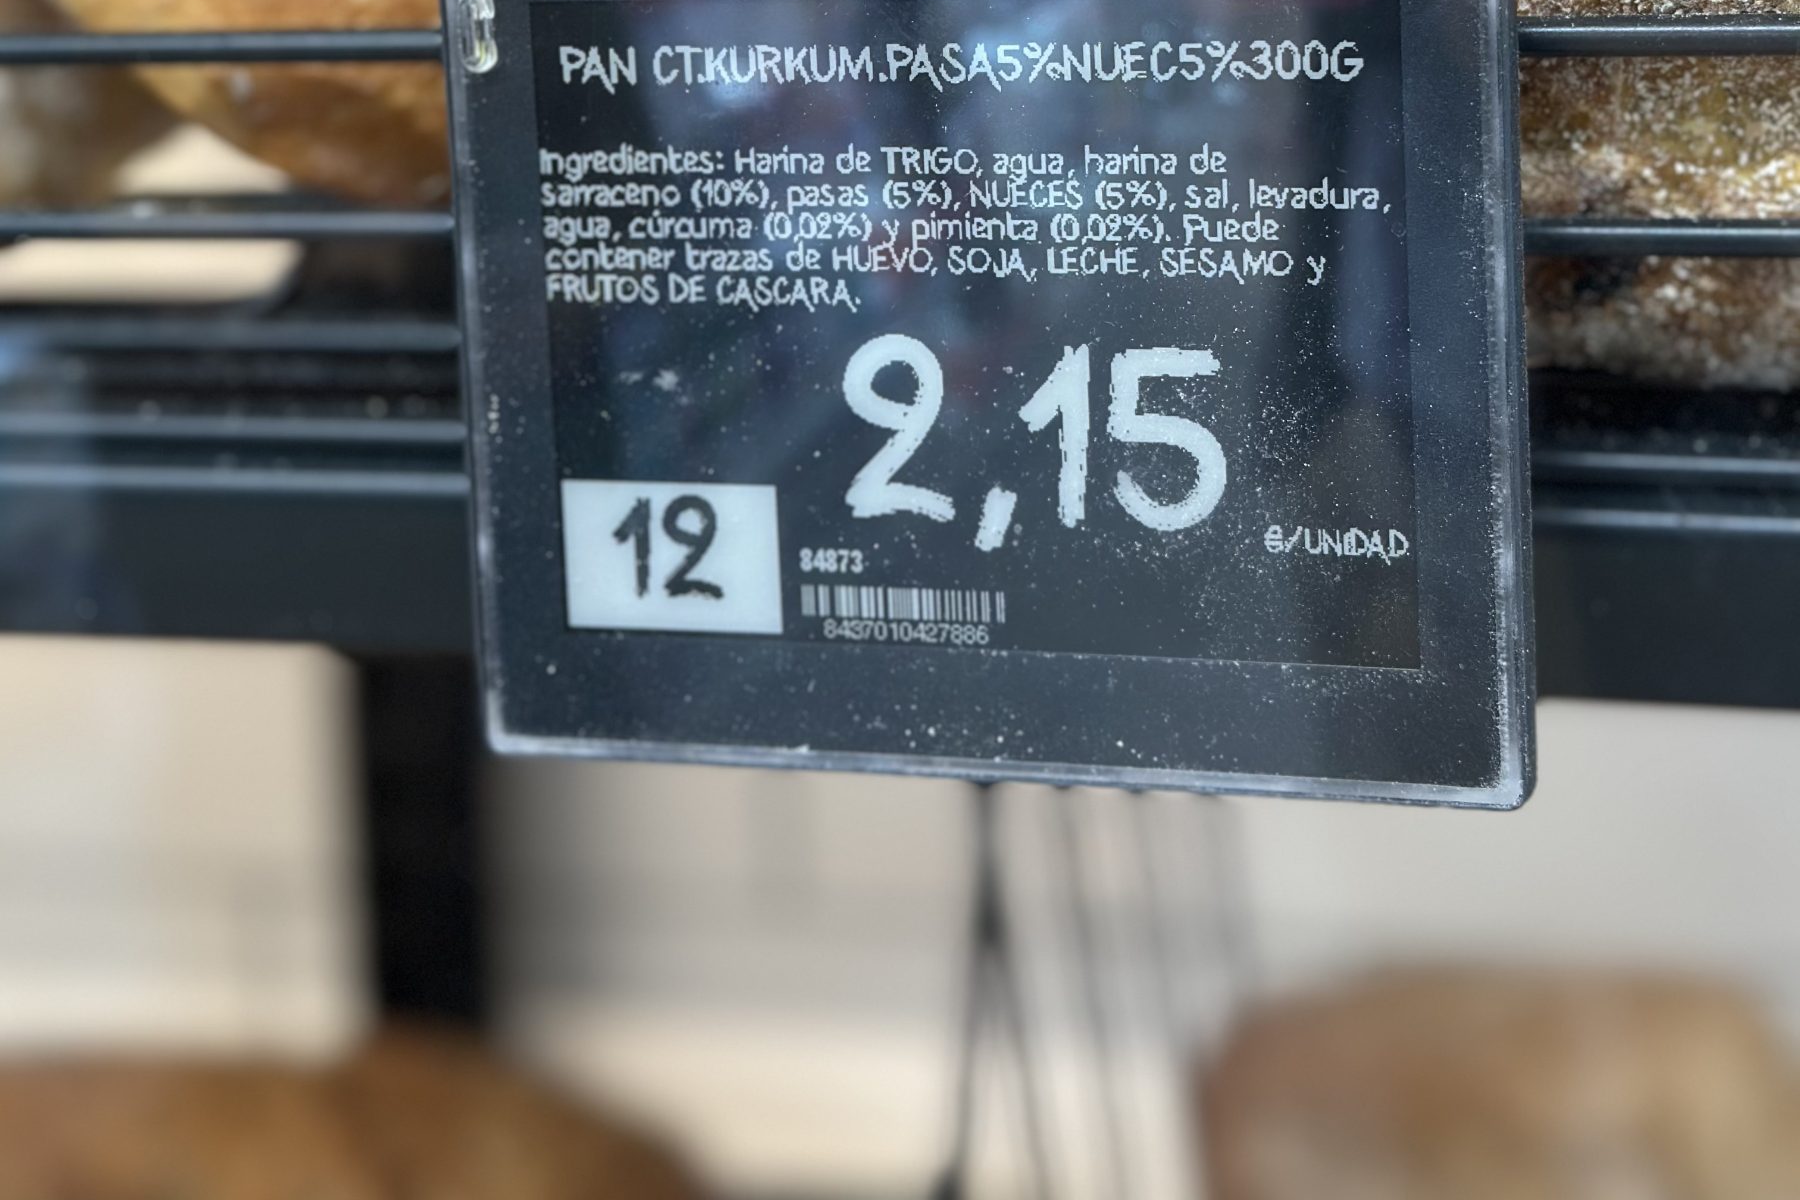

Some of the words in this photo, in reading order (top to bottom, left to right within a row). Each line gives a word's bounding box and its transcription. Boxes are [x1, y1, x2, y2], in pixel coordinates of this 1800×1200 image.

[559, 45, 637, 94] PAN
[539, 142, 725, 182] Ingredientes:
[734, 145, 824, 174] Harina
[836, 143, 871, 174] de
[881, 147, 983, 178] TRIGO,
[993, 153, 1075, 185] agua,
[1084, 144, 1177, 176] harina
[1190, 143, 1227, 174] de
[540, 182, 681, 207] sarraceno
[690, 178, 778, 212] (10%),
[787, 184, 869, 214] pasas
[882, 180, 960, 212] (5%),
[970, 180, 1084, 211] NUECES
[1095, 180, 1176, 213] (5%),
[1185, 178, 1240, 212] sal,
[1250, 176, 1391, 214] levadura,
[542, 215, 621, 246] agua,
[628, 209, 752, 239] cúrcuma
[763, 212, 872, 242] (0,02%)
[881, 219, 900, 250] y
[912, 211, 1037, 250] pimienta
[1051, 213, 1171, 244] (0,02%).
[1183, 210, 1279, 246] Puede
[544, 243, 675, 271] contener
[685, 242, 773, 272] trazas
[785, 241, 822, 271] de
[832, 246, 938, 277] HUEVO,
[947, 247, 1037, 282] SOJA,
[1046, 246, 1149, 279] LECHE,
[1306, 256, 1326, 285] y
[546, 273, 660, 304] FRUTOS
[668, 274, 706, 303] DE
[843, 333, 1227, 552] 2,15
[613, 495, 725, 598] 12
[800, 547, 864, 573] 84873
[1264, 524, 1409, 566] €/UNIDAD
[823, 618, 989, 645] 8437010427886
